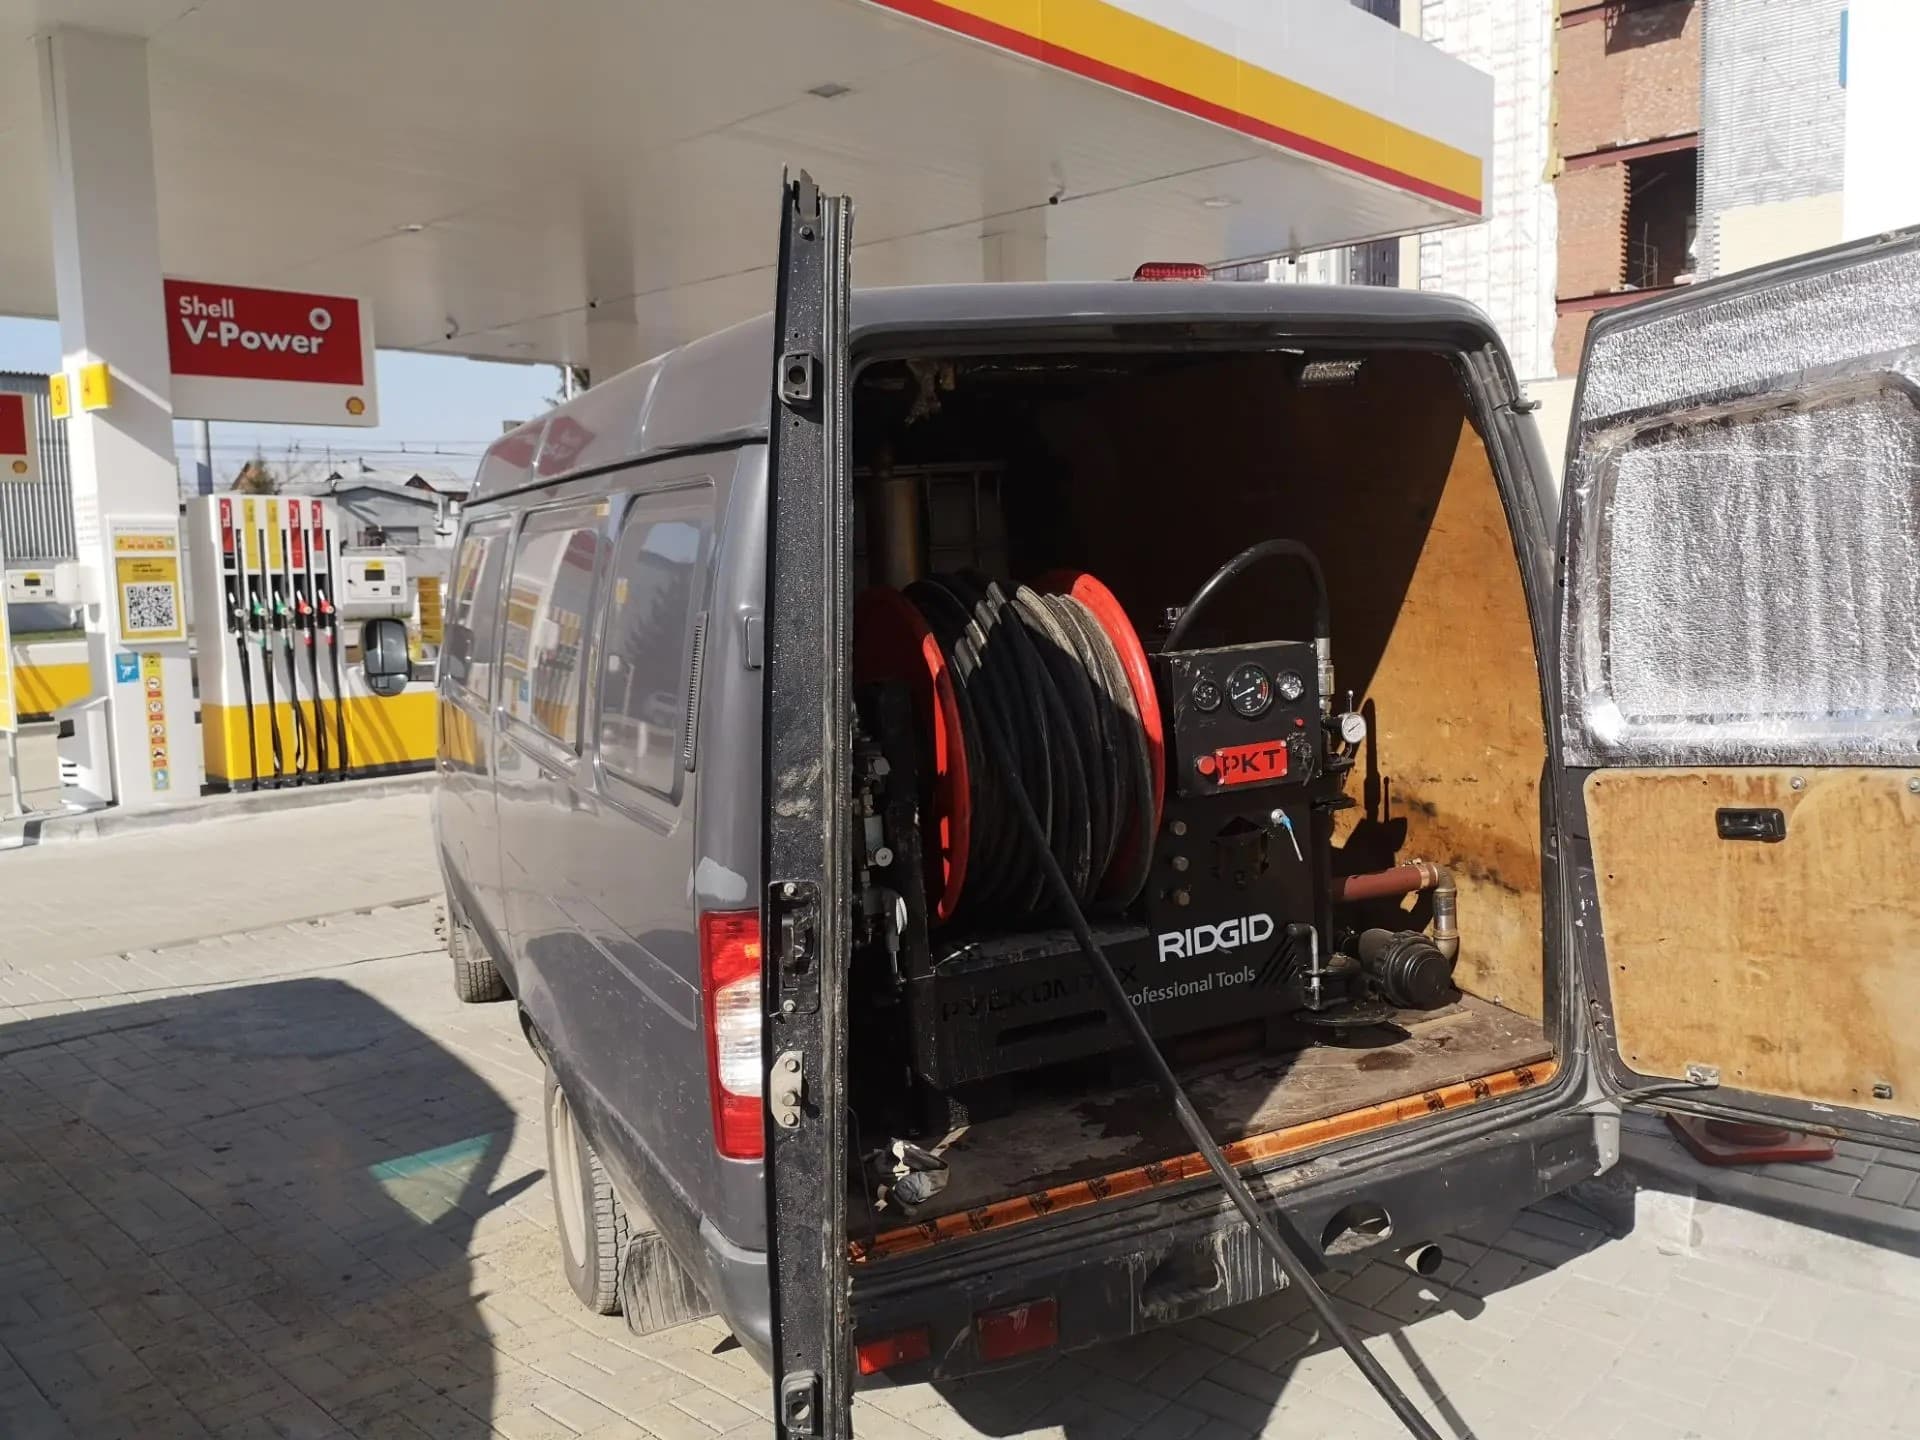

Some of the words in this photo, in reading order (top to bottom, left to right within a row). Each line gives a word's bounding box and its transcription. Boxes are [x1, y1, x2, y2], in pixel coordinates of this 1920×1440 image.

[179, 296, 235, 318] Shell
[181, 317, 323, 354] V-Power
[55, 384, 63, 406] 3
[1158, 913, 1275, 962] RIDGID
[1127, 973, 1213, 1006] rofessional
[1216, 965, 1256, 988] Tools
